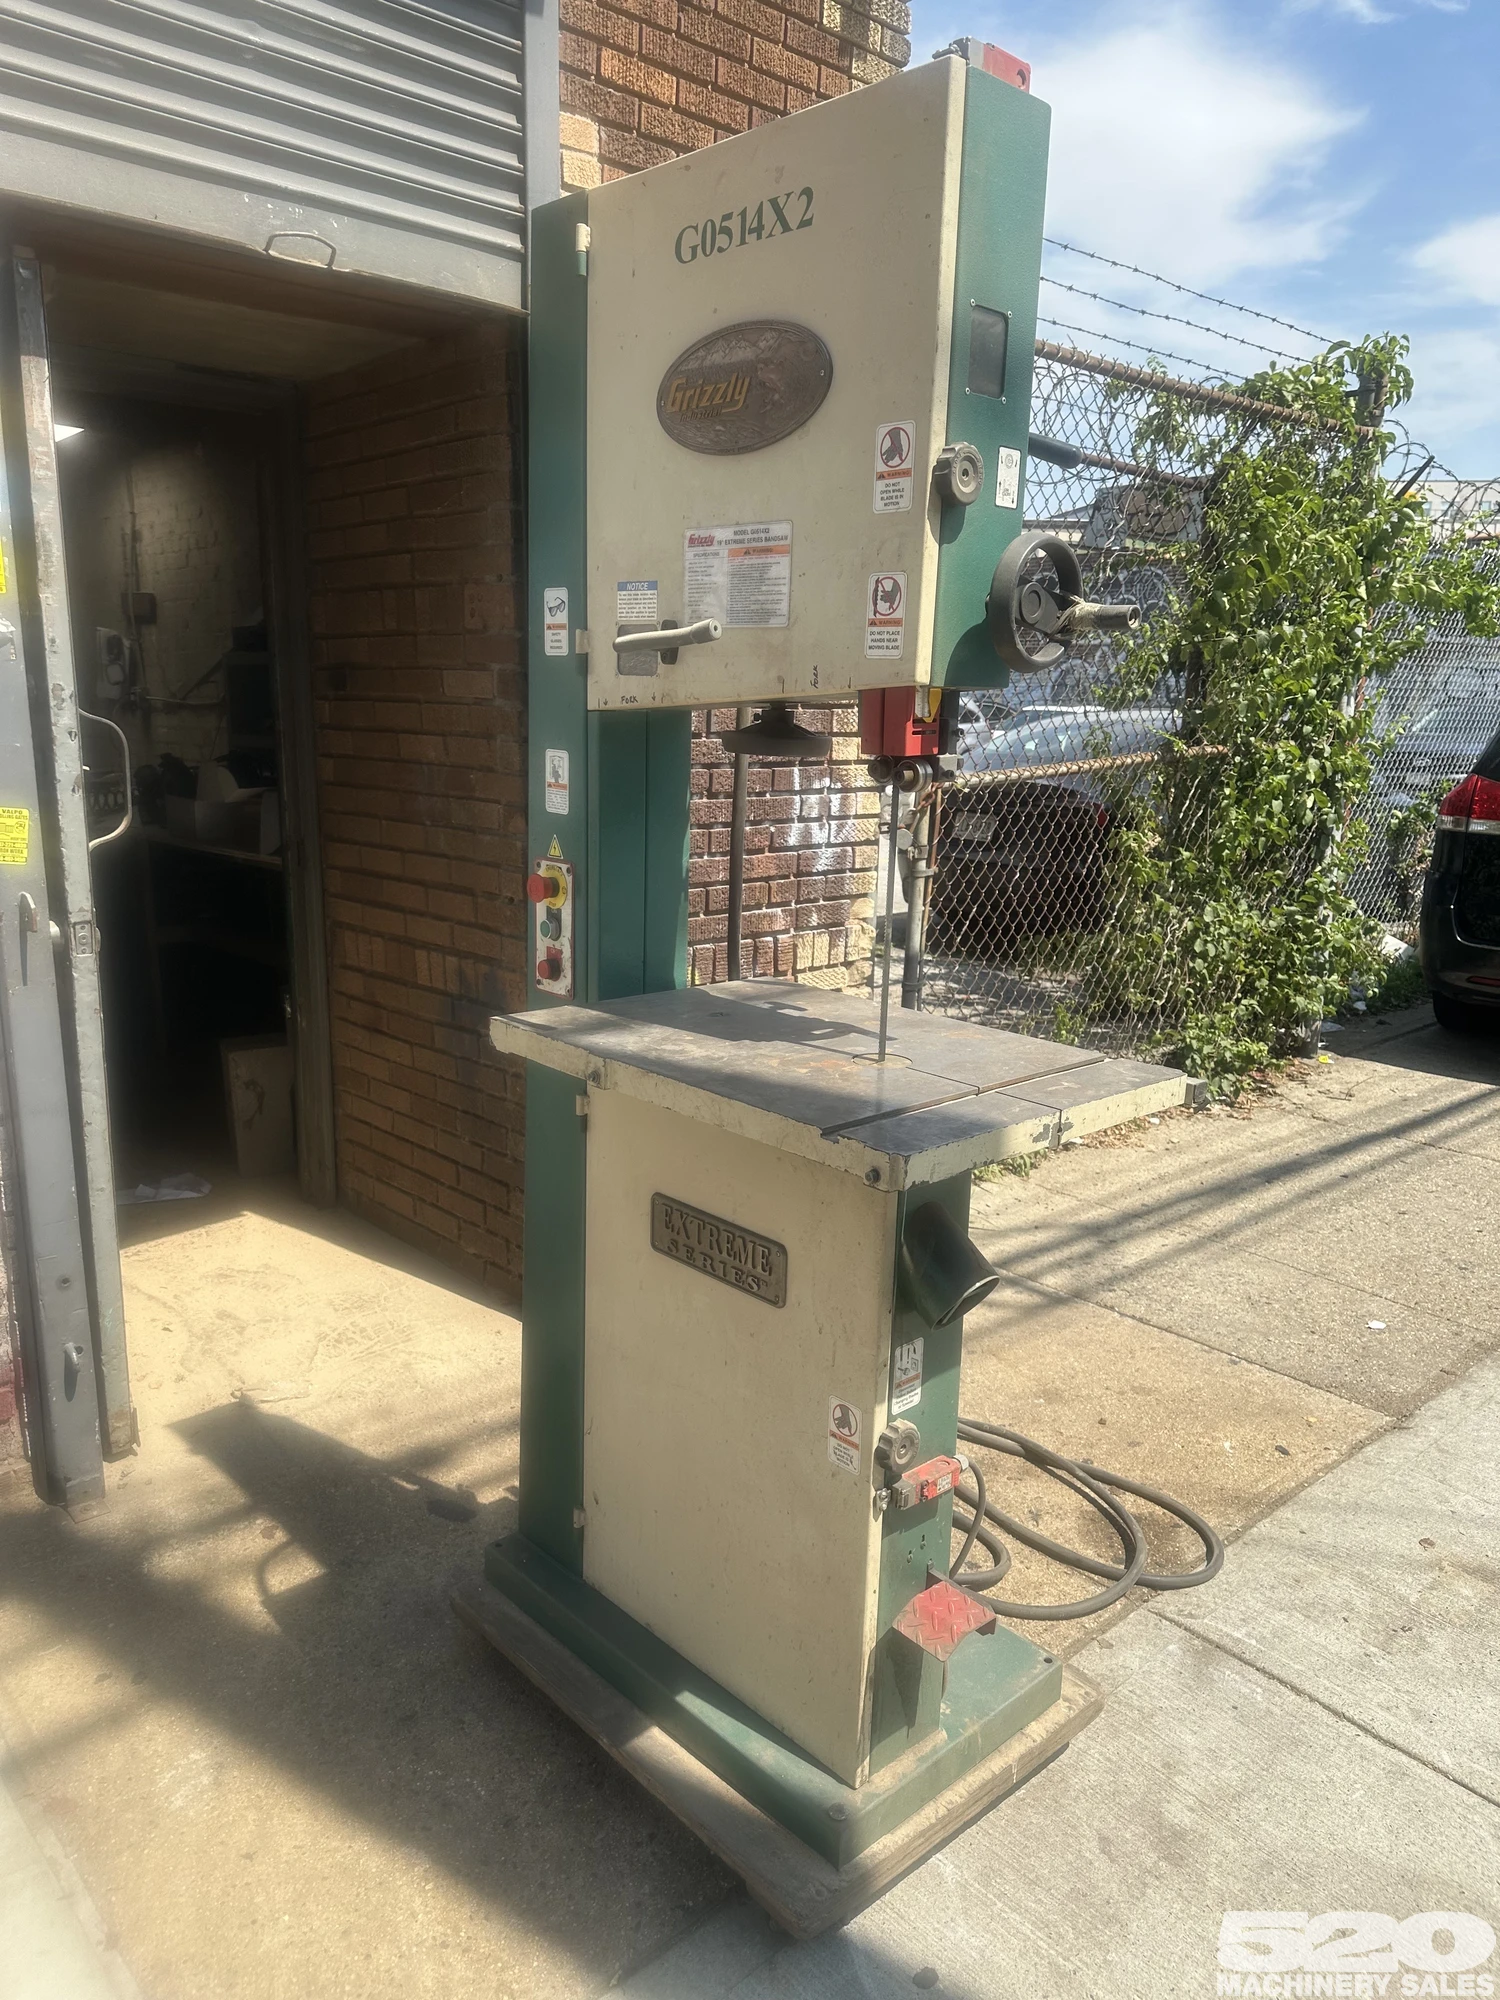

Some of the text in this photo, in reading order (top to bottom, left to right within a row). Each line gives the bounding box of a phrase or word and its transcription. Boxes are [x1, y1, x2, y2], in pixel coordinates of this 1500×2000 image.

[674, 186, 815, 264] G0514X2
[665, 373, 750, 414] Grizzly
[688, 533, 716, 547] Grizzly
[724, 538, 747, 546] EXTREME
[764, 535, 789, 543] BANDSAW
[626, 582, 649, 591] NOTICE
[621, 695, 639, 704] FORK
[661, 1202, 773, 1277] EXTREME
[667, 1238, 760, 1292] SERIES
